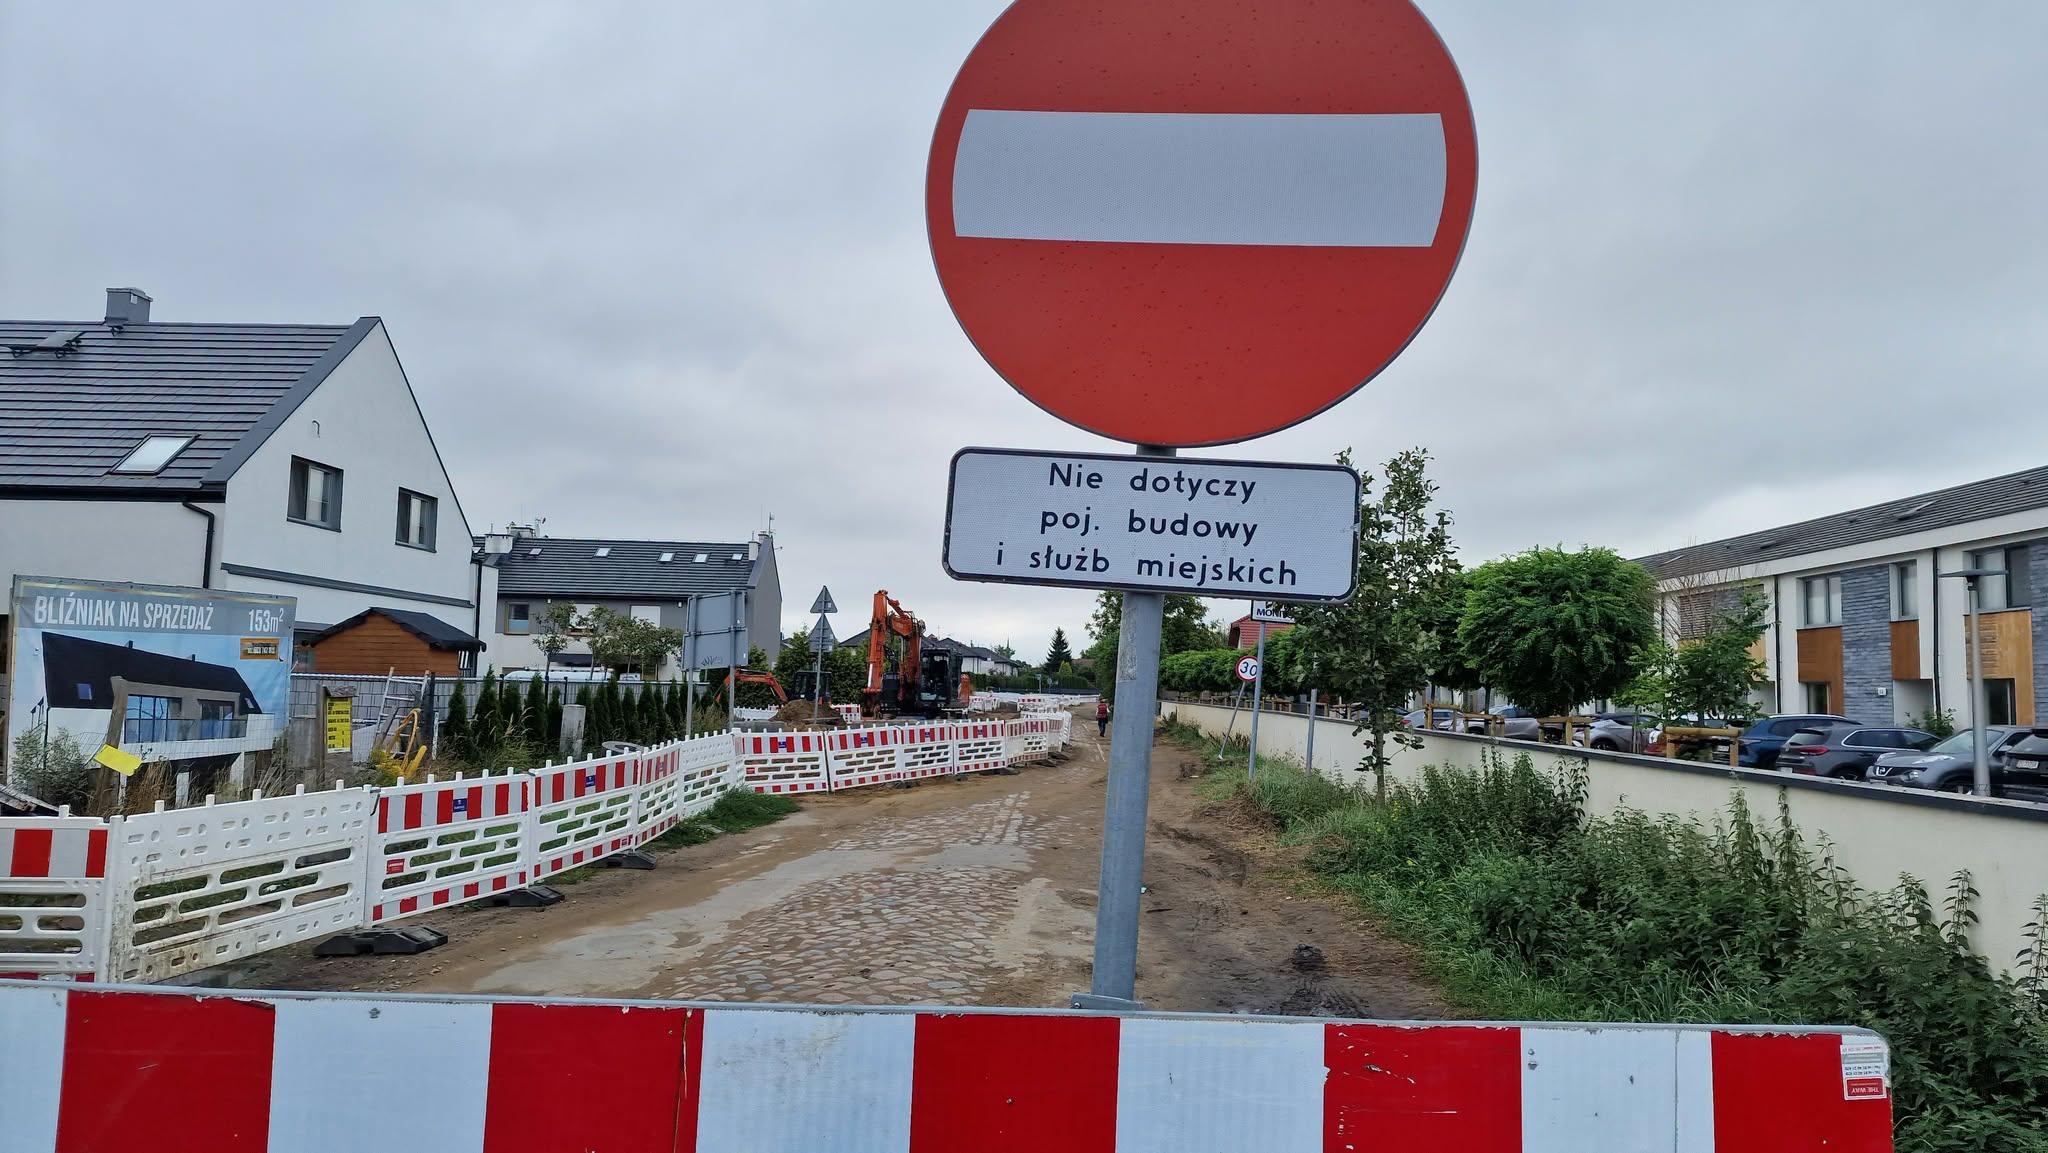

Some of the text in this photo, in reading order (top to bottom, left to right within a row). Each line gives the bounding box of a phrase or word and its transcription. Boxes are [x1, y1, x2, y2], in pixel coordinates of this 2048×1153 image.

[1050, 462, 1256, 504] Nie dotyczy
[1040, 506, 1258, 547] poj. budowy
[996, 541, 1297, 586] i służb miejskich
[34, 592, 214, 631] BLIŹNIAK NA SPRZEDAŻ
[1239, 661, 1258, 677] 30
